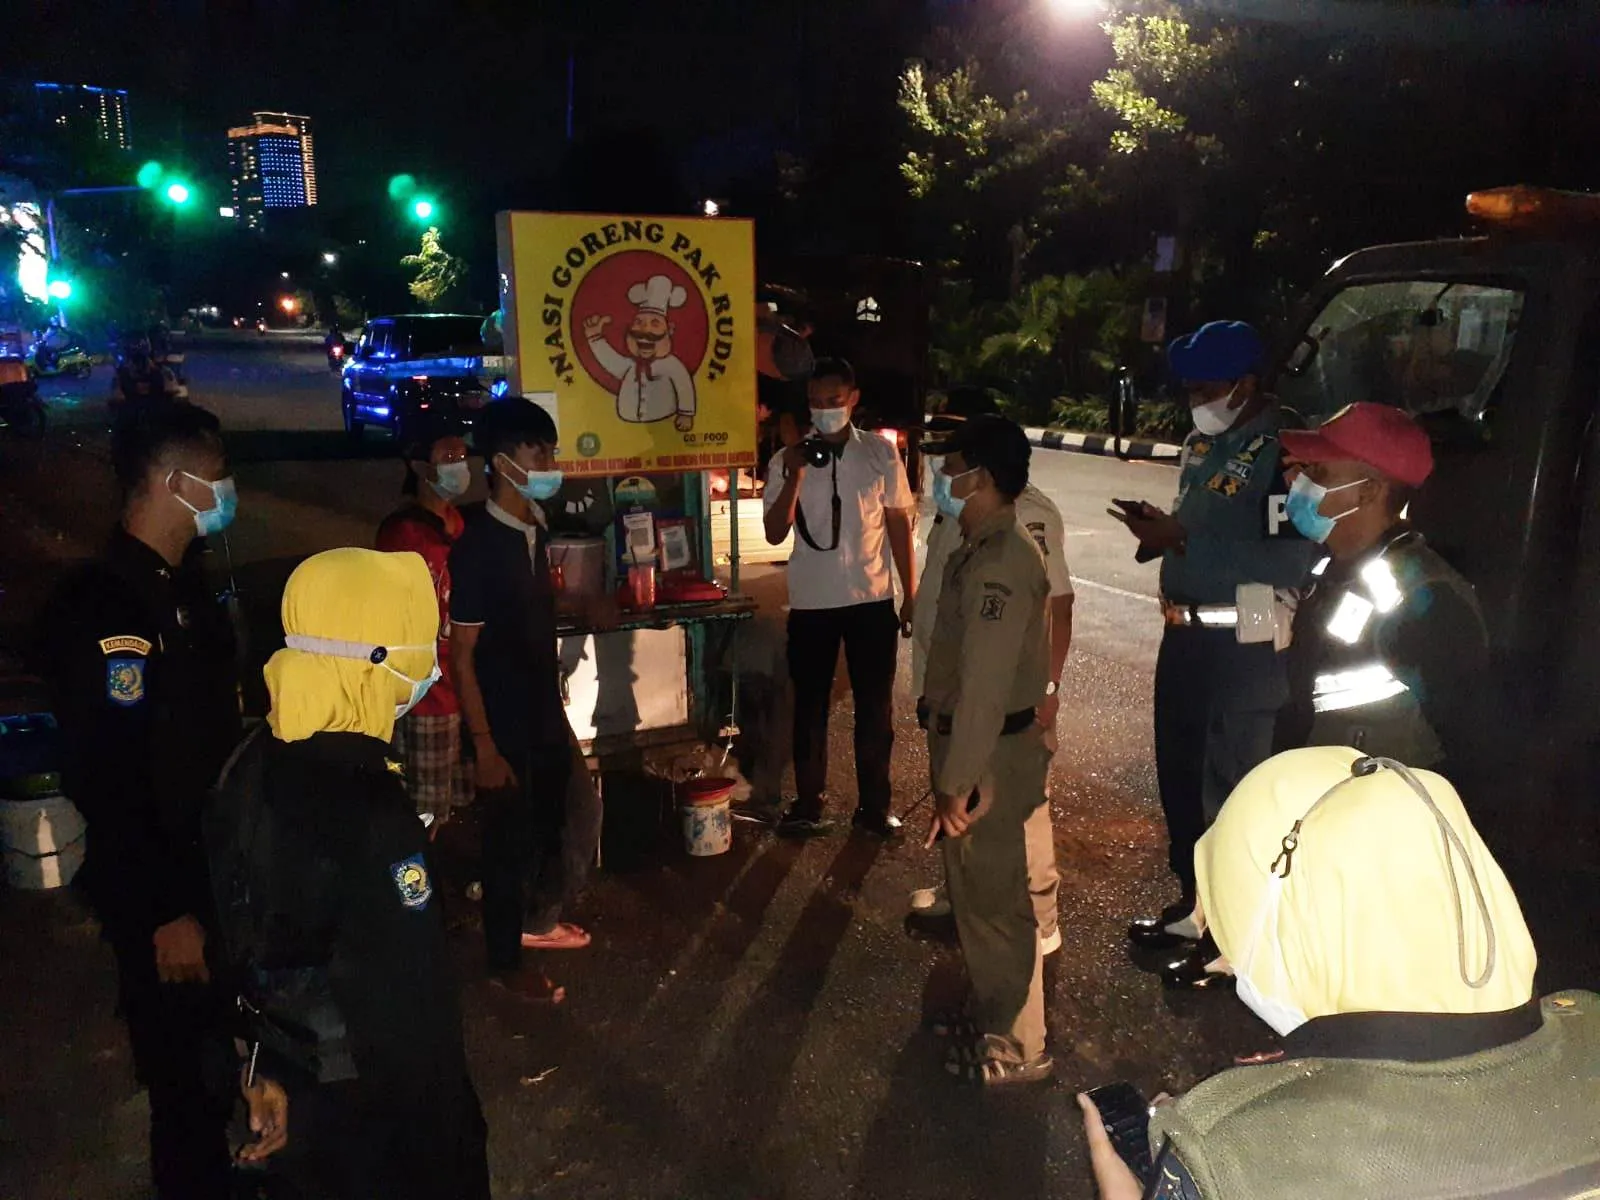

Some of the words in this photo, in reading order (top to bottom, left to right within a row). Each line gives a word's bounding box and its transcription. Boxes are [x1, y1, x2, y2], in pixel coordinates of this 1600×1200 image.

[552, 221, 664, 288] GORENG
[671, 232, 720, 290] PAK
[543, 294, 574, 378] NASI
[710, 293, 733, 375] RUDI
[704, 432, 728, 441] FOOD
